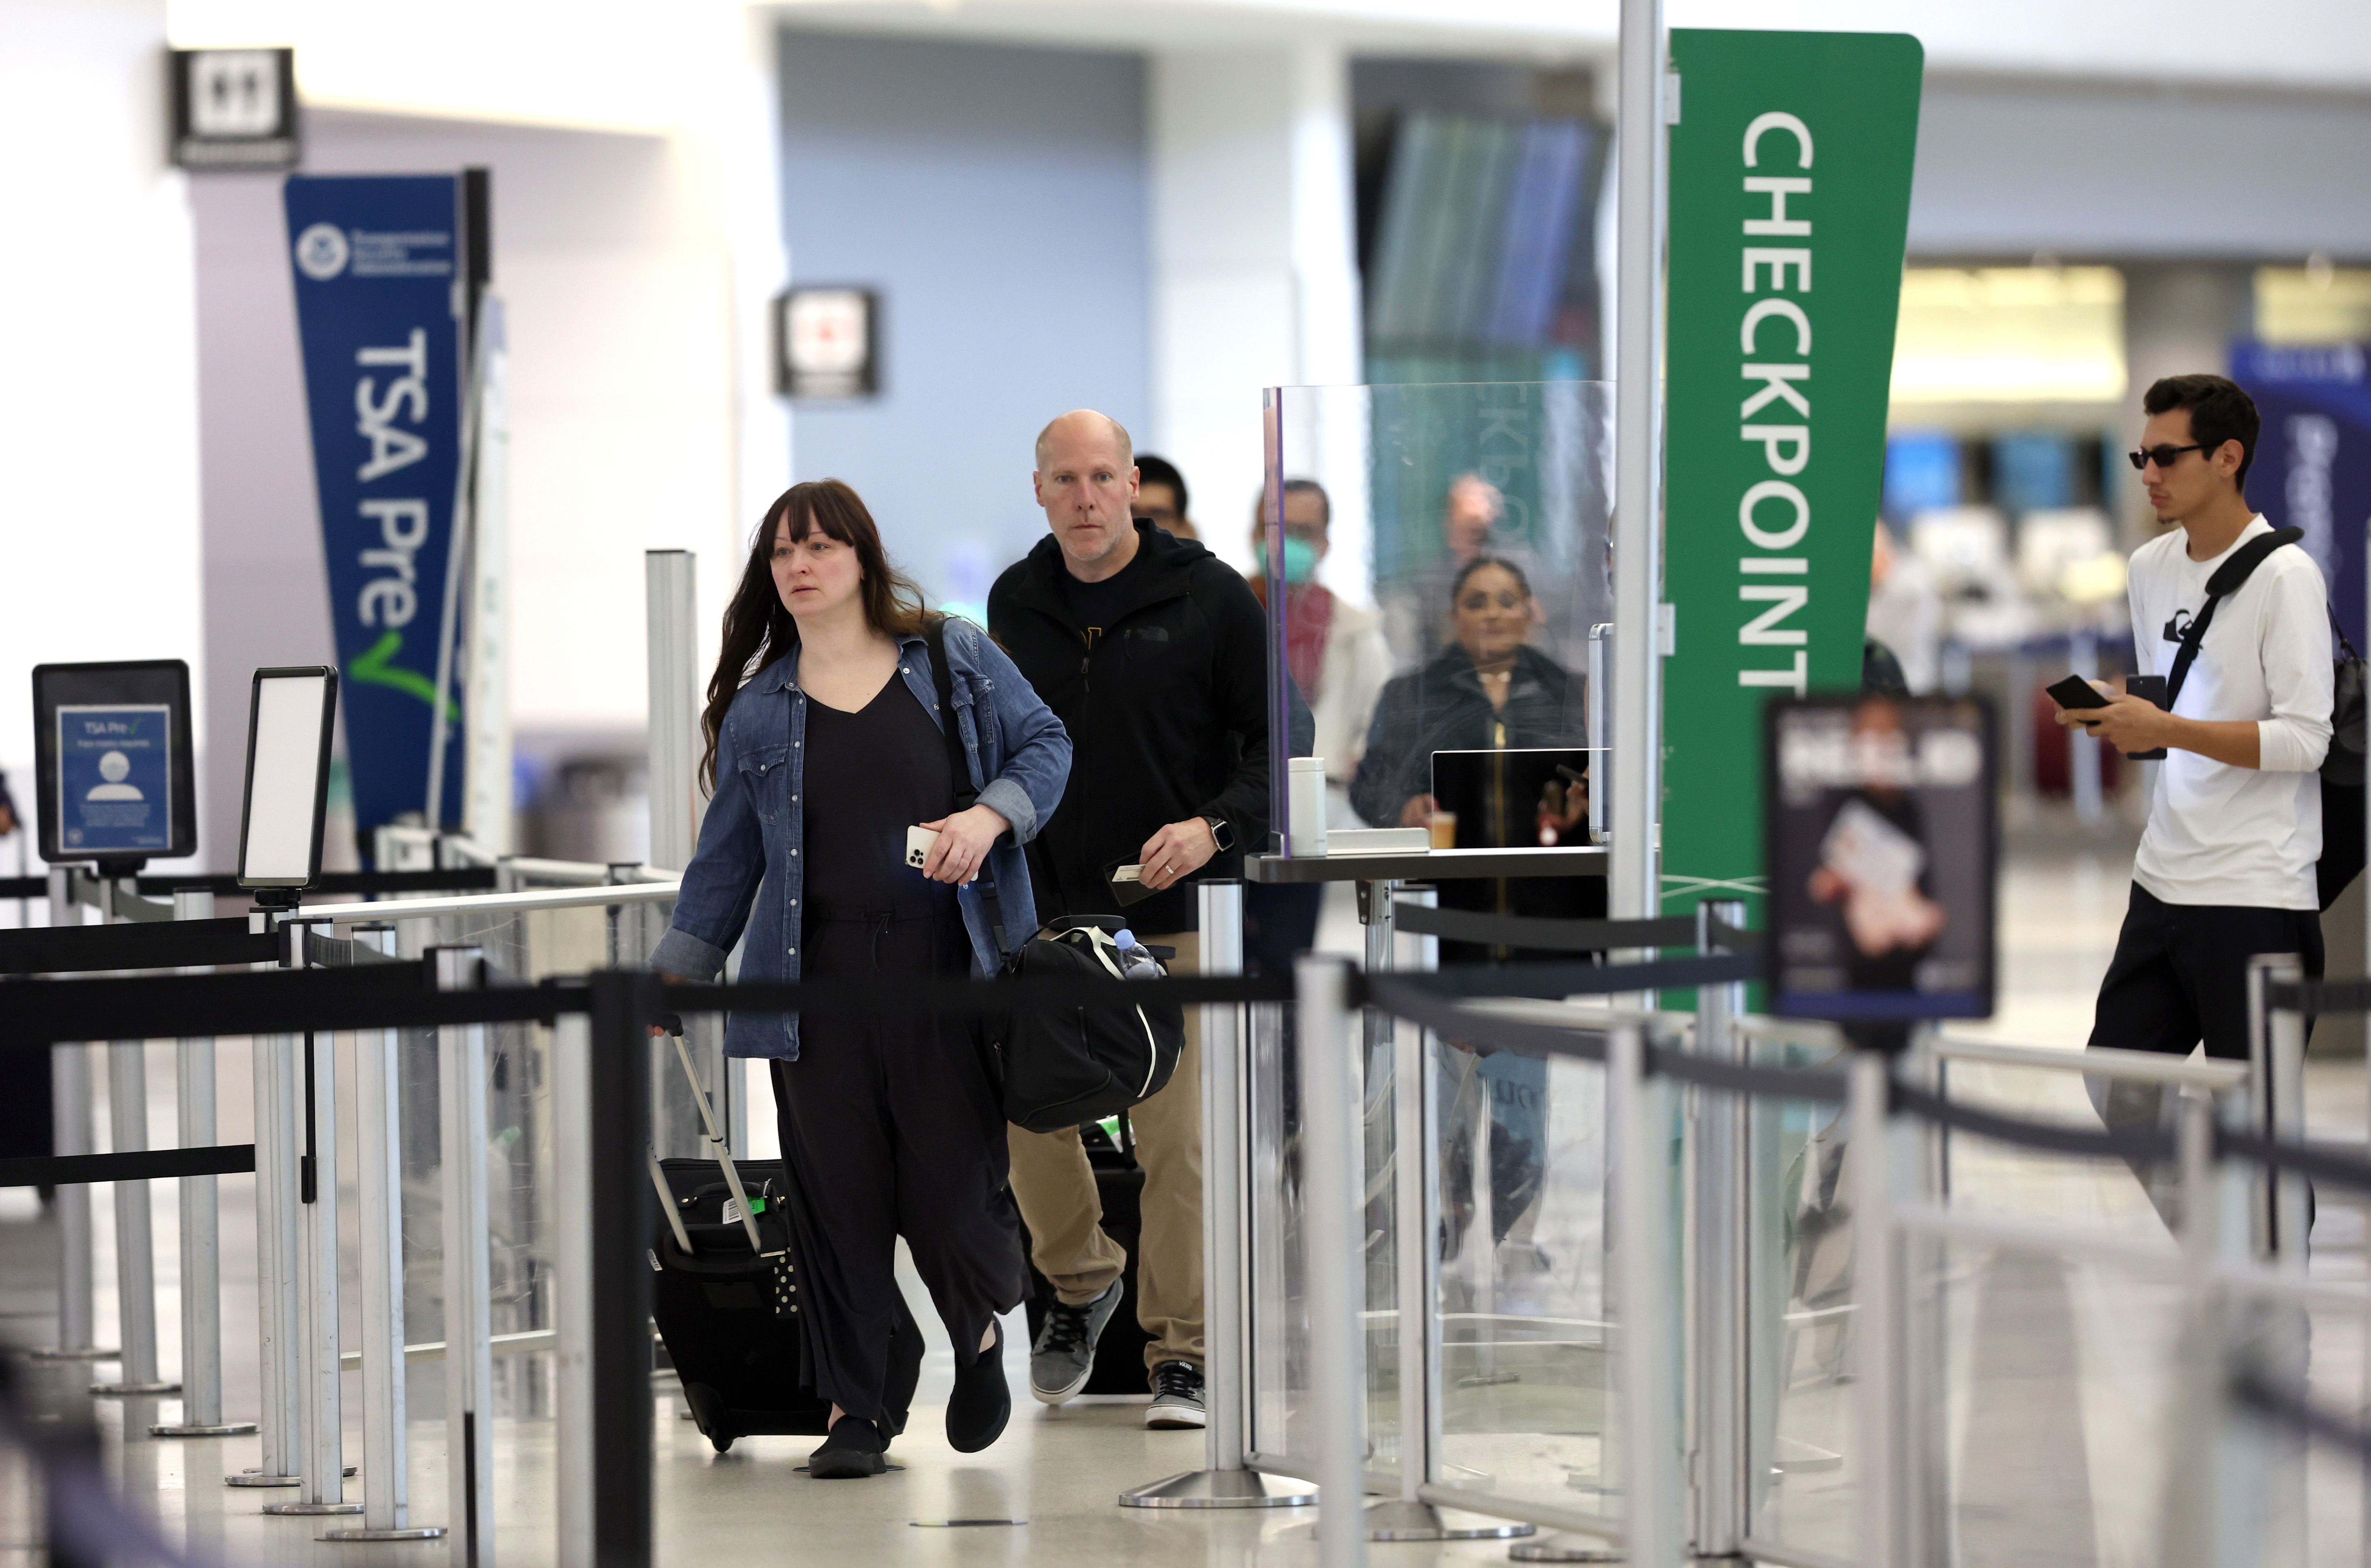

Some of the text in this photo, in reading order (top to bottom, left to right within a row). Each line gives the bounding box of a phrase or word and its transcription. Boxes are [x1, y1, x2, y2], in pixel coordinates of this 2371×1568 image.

[354, 328, 428, 482] TSA
[1738, 111, 1814, 698] CHECKPOINT
[356, 498, 429, 628] Pre
[1179, 1361, 1192, 1370] VANS
